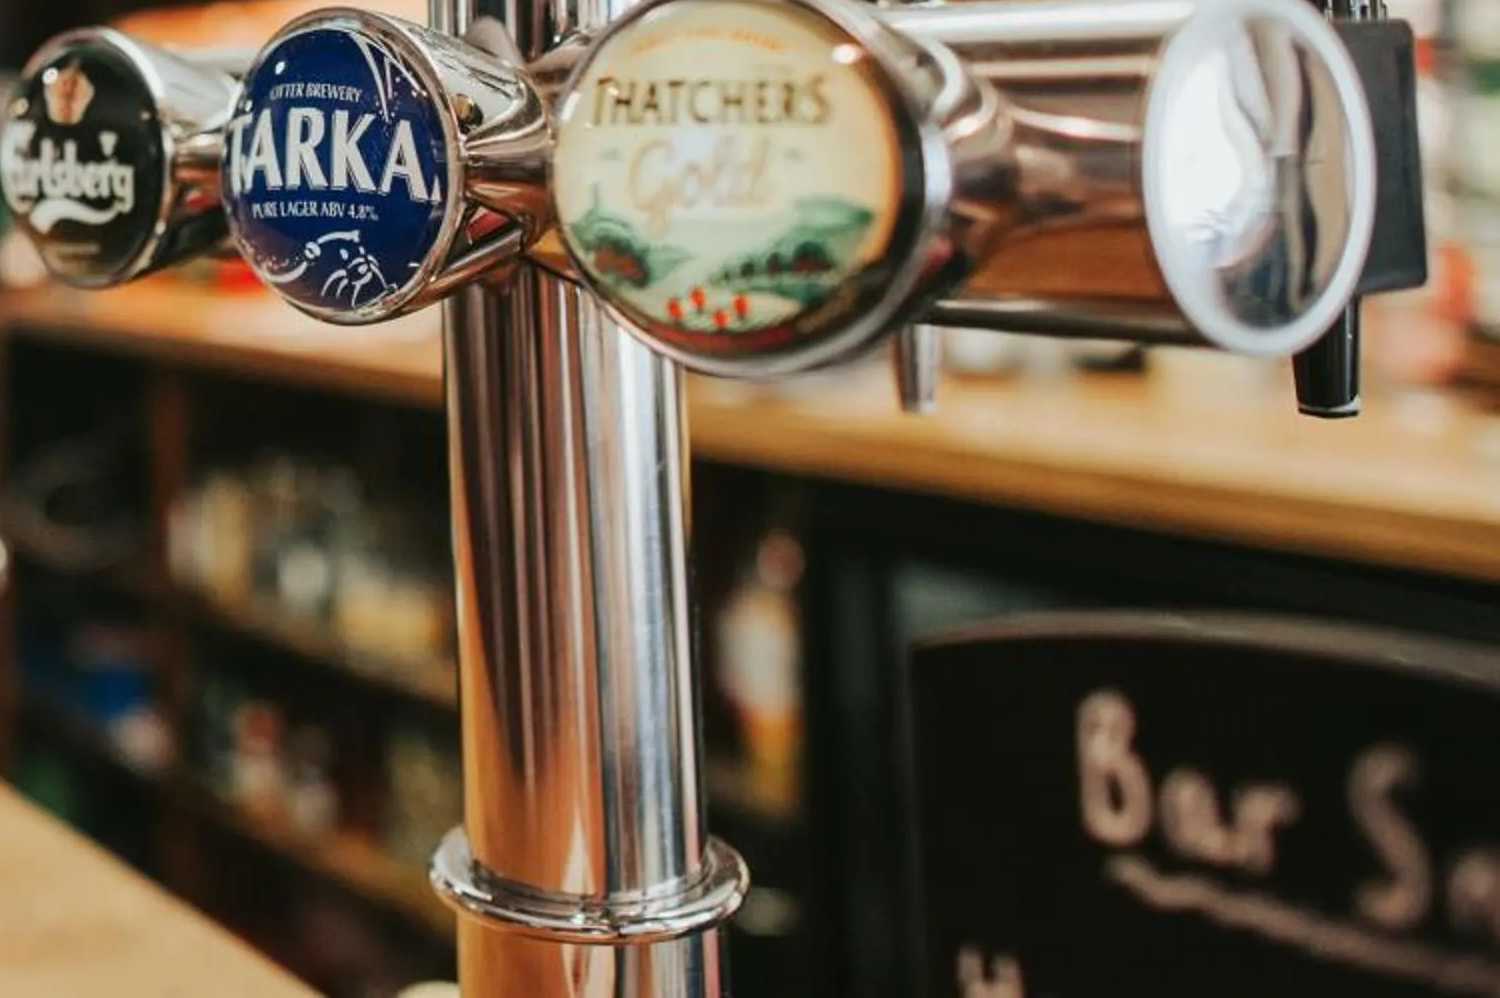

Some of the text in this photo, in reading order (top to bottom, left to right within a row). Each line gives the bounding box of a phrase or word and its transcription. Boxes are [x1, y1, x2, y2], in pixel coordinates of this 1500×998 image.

[269, 82, 362, 102] OTTER BREWERY
[592, 74, 833, 126] THATCHERS
[226, 106, 430, 203] TARKA
[627, 136, 772, 238] Gold
[252, 201, 277, 219] PURE
[279, 201, 318, 218] LAGER
[320, 203, 345, 218] ABV
[1077, 688, 1296, 870] Bar
